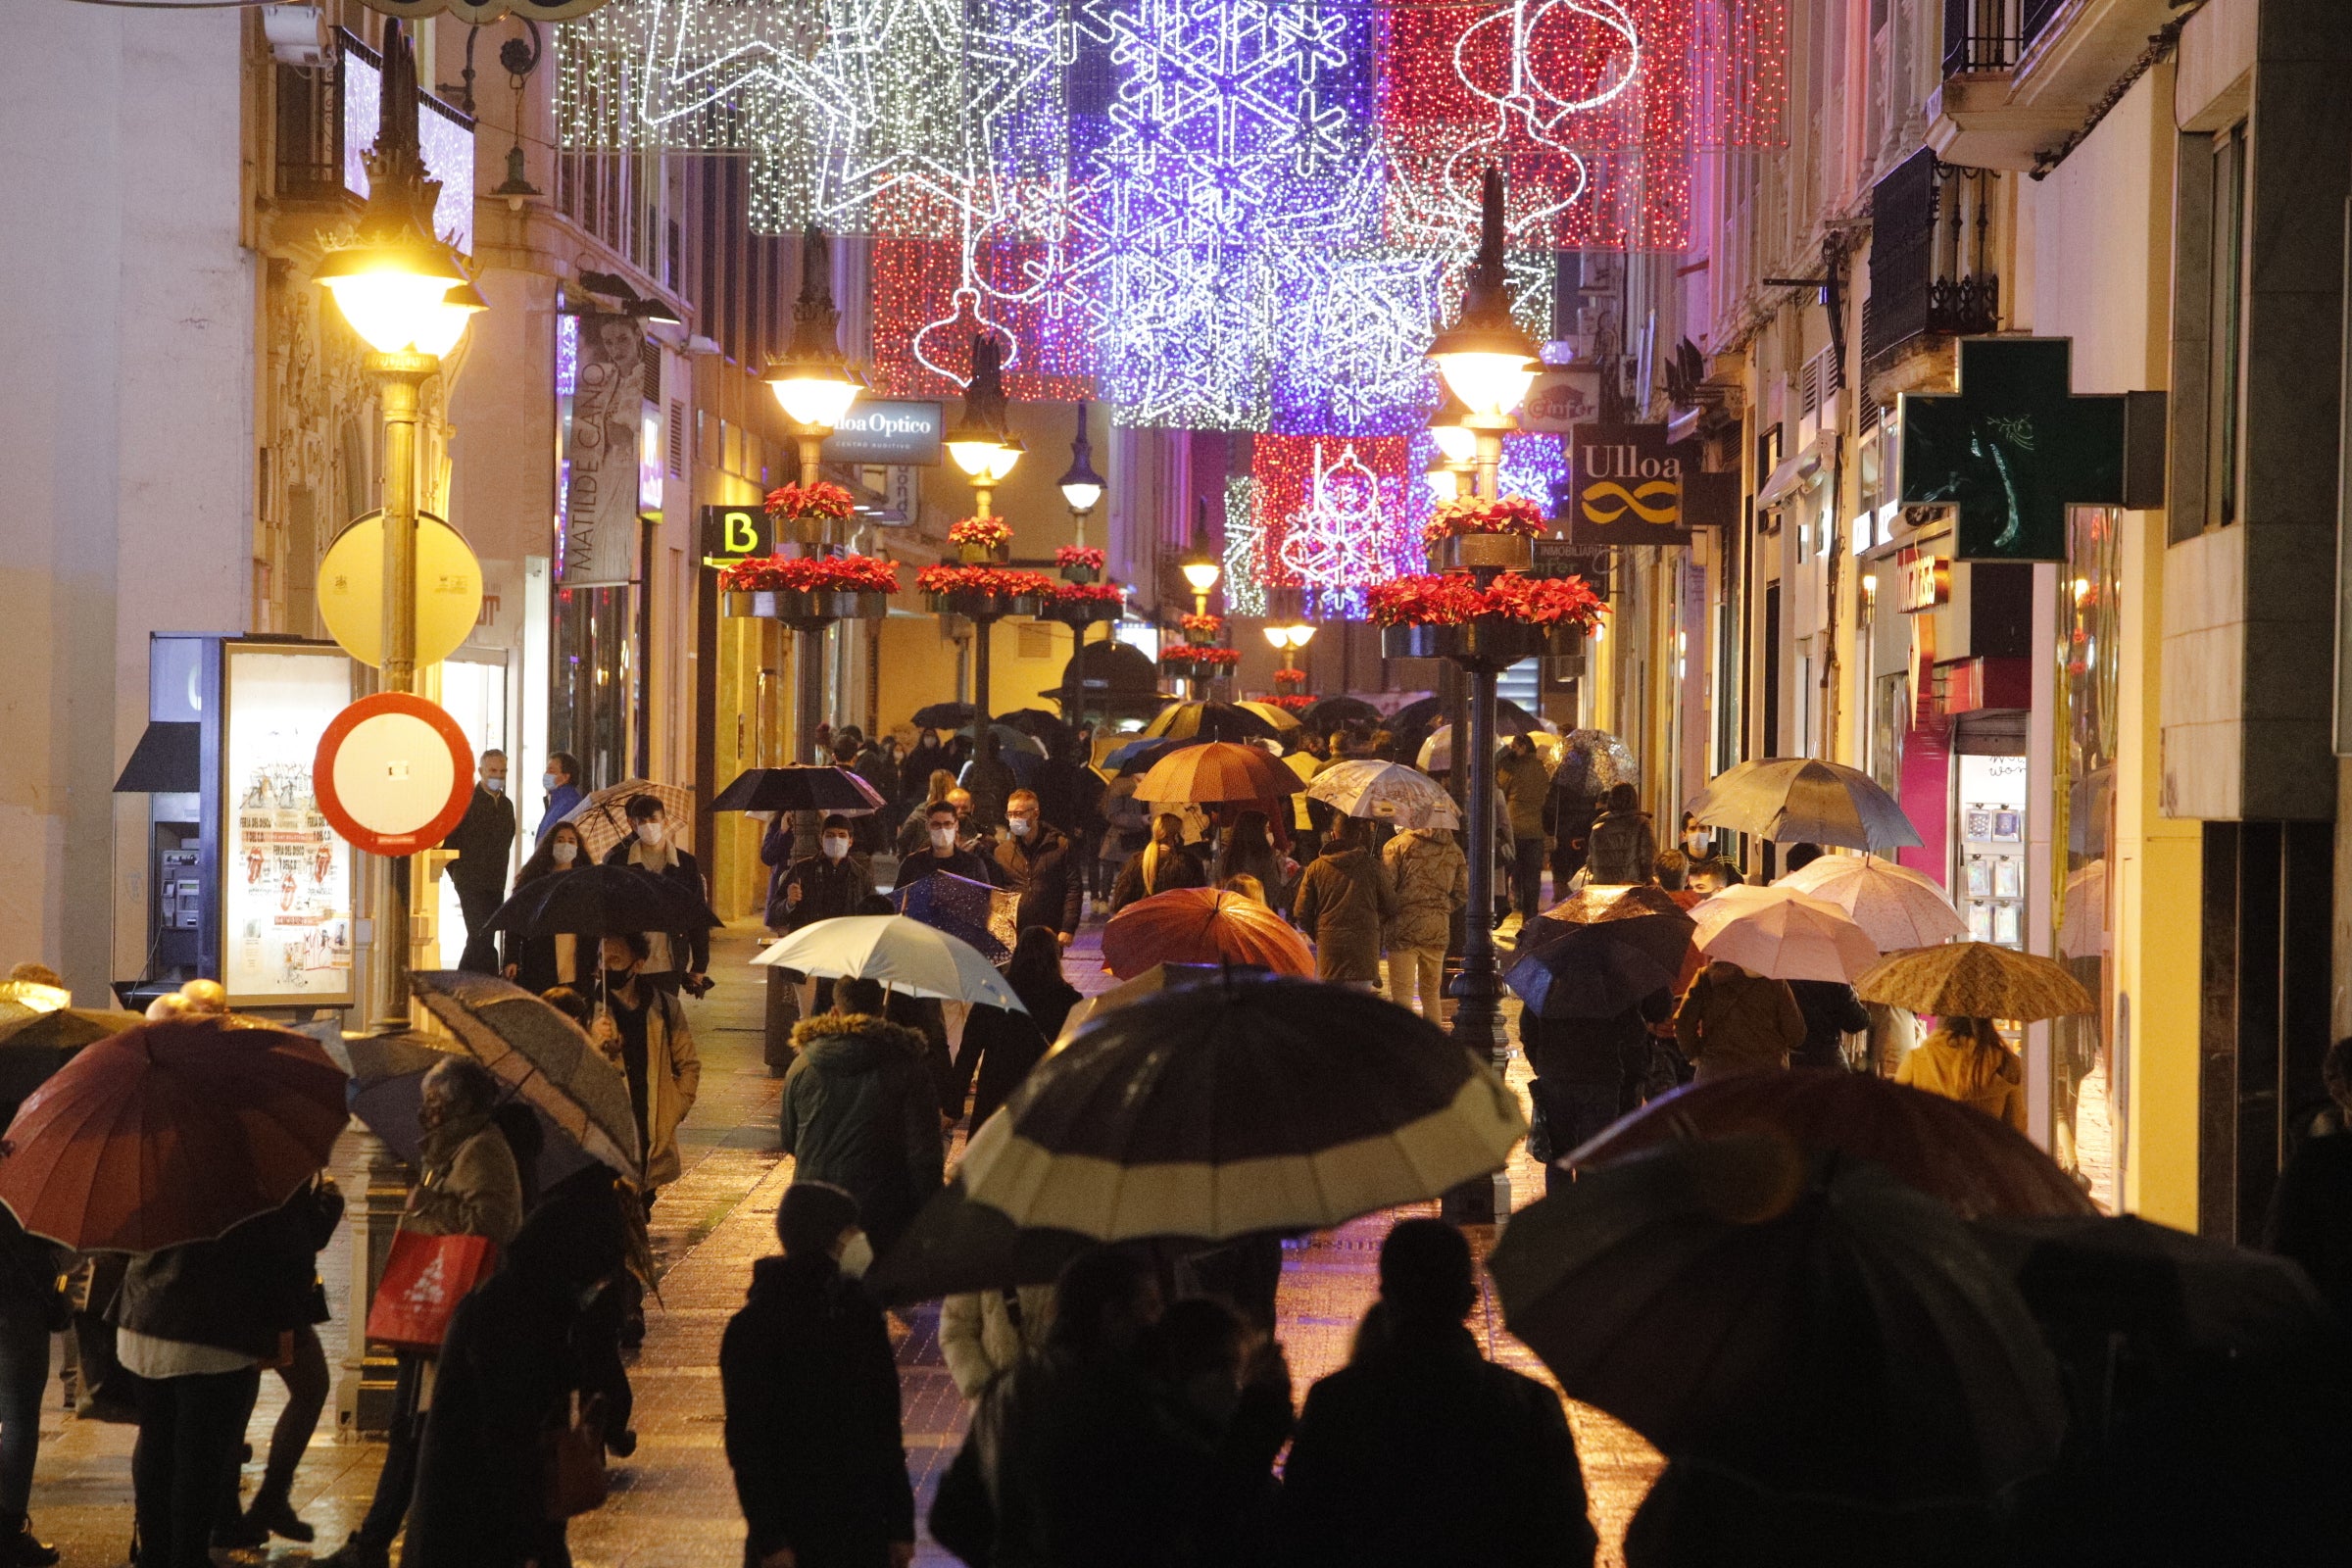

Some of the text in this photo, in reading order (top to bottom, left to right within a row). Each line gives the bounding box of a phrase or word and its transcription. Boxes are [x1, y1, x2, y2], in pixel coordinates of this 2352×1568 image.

[869, 413, 931, 438] Optico
[570, 363, 606, 571] MATILDE CANO
[1582, 444, 1682, 478] Ulloa
[725, 512, 758, 553] B
